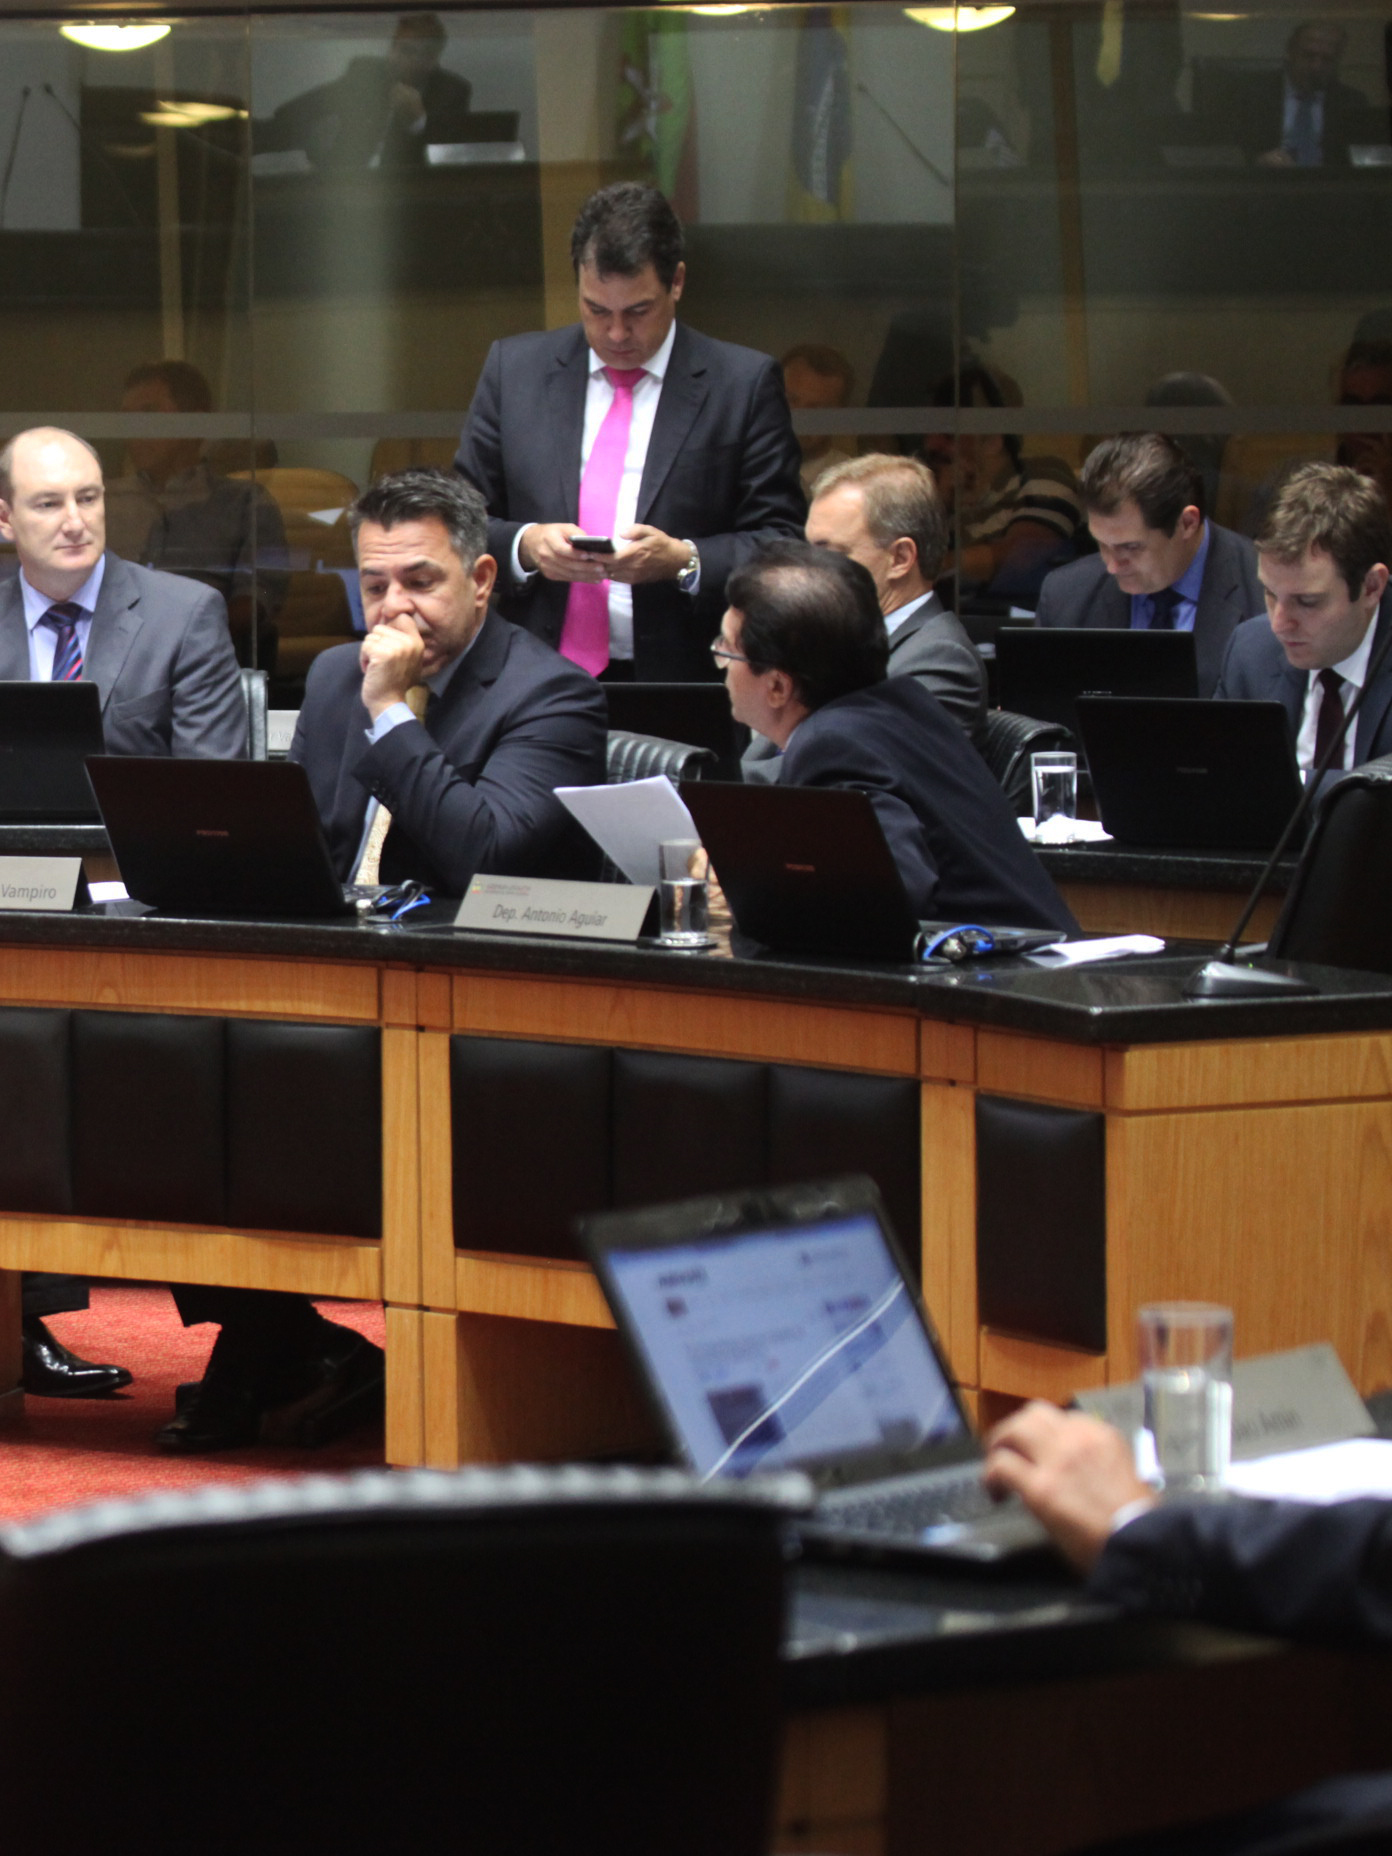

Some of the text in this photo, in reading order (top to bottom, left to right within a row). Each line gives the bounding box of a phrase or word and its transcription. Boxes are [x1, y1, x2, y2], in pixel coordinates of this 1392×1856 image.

[1, 884, 57, 903] Vampiro
[492, 903, 607, 928] Dep. Antonio Aguiar
